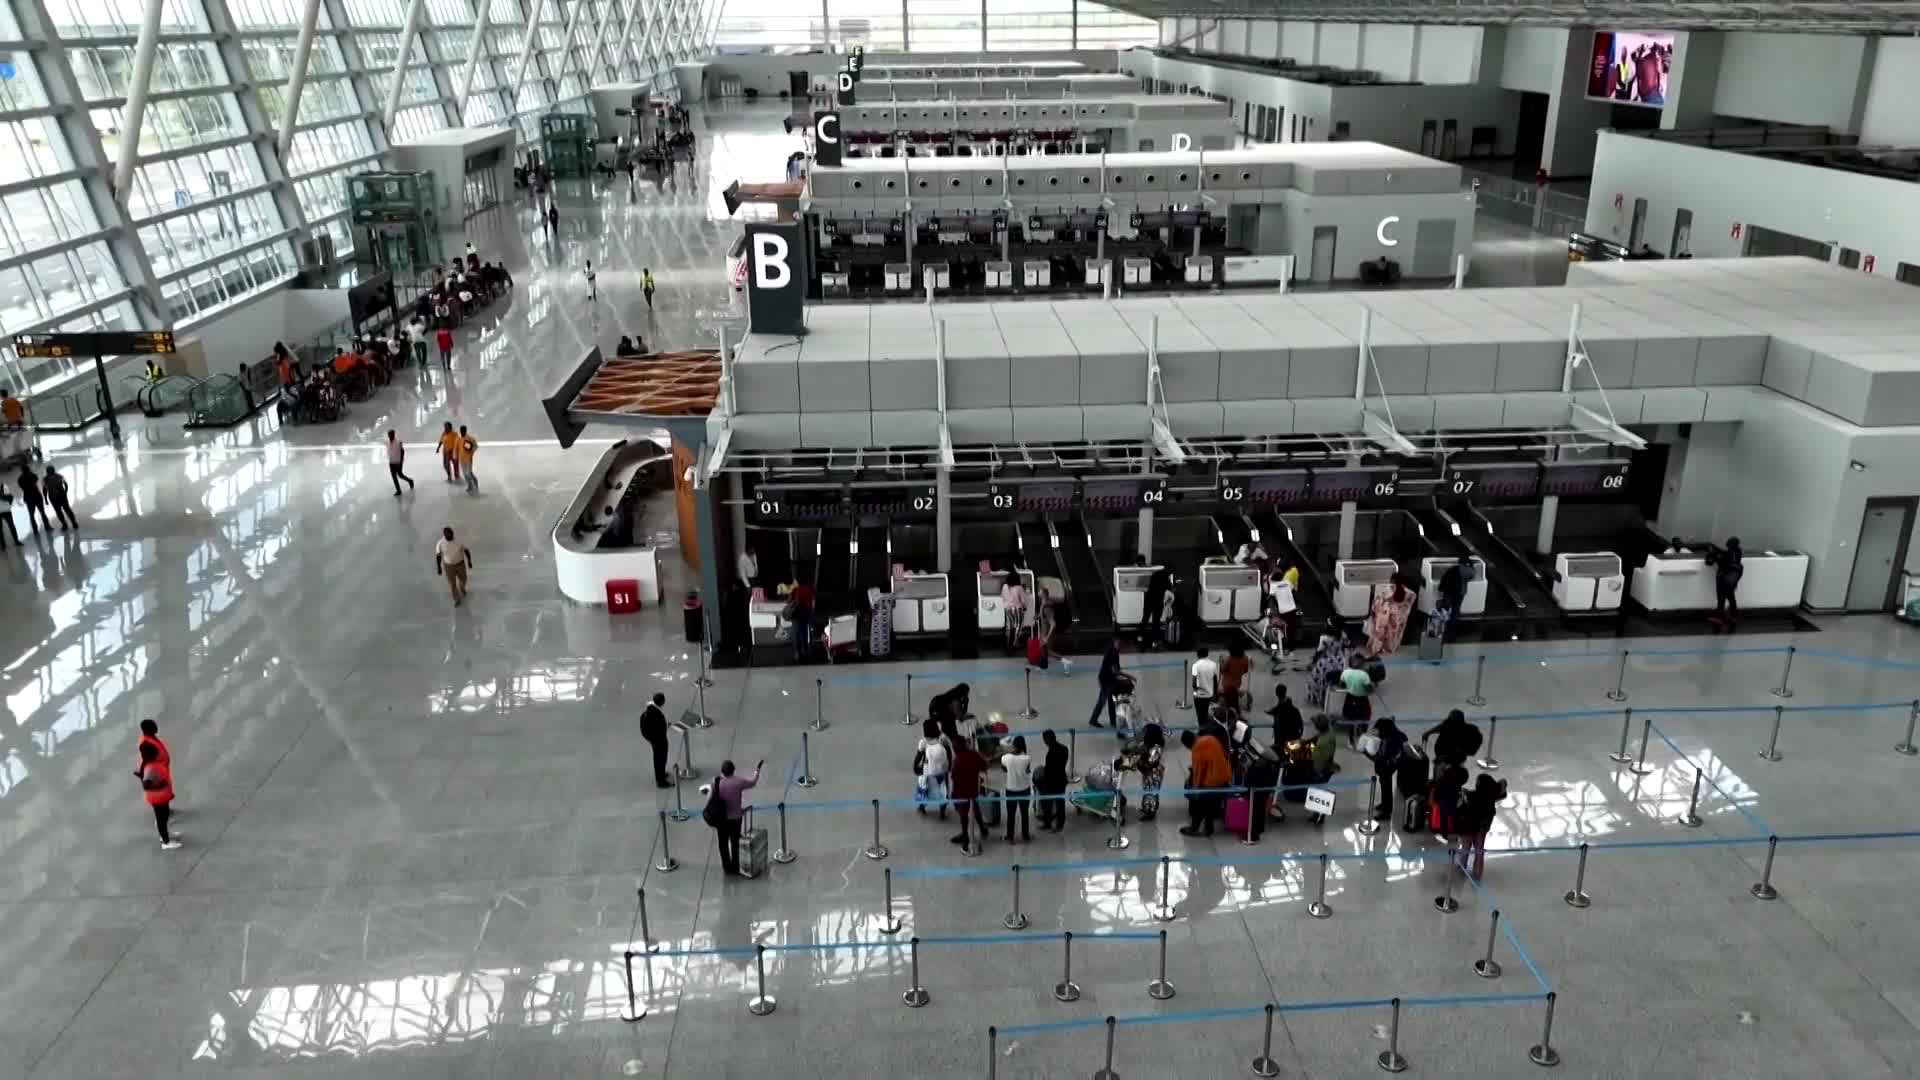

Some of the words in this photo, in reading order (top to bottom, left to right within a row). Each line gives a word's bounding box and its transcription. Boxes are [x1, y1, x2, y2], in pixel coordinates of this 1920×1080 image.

[849, 57, 858, 71] E
[840, 73, 853, 92] D
[817, 115, 838, 144] C
[1171, 133, 1191, 152] D
[1377, 216, 1400, 246] C
[753, 232, 791, 288] B
[1453, 481, 1473, 494] 07
[1603, 475, 1623, 488] 08
[1223, 487, 1243, 500] 05
[1375, 483, 1395, 496] 06
[993, 495, 1013, 508] 03
[1143, 491, 1163, 502] 04
[760, 501, 780, 514] 01
[914, 497, 933, 510] 02
